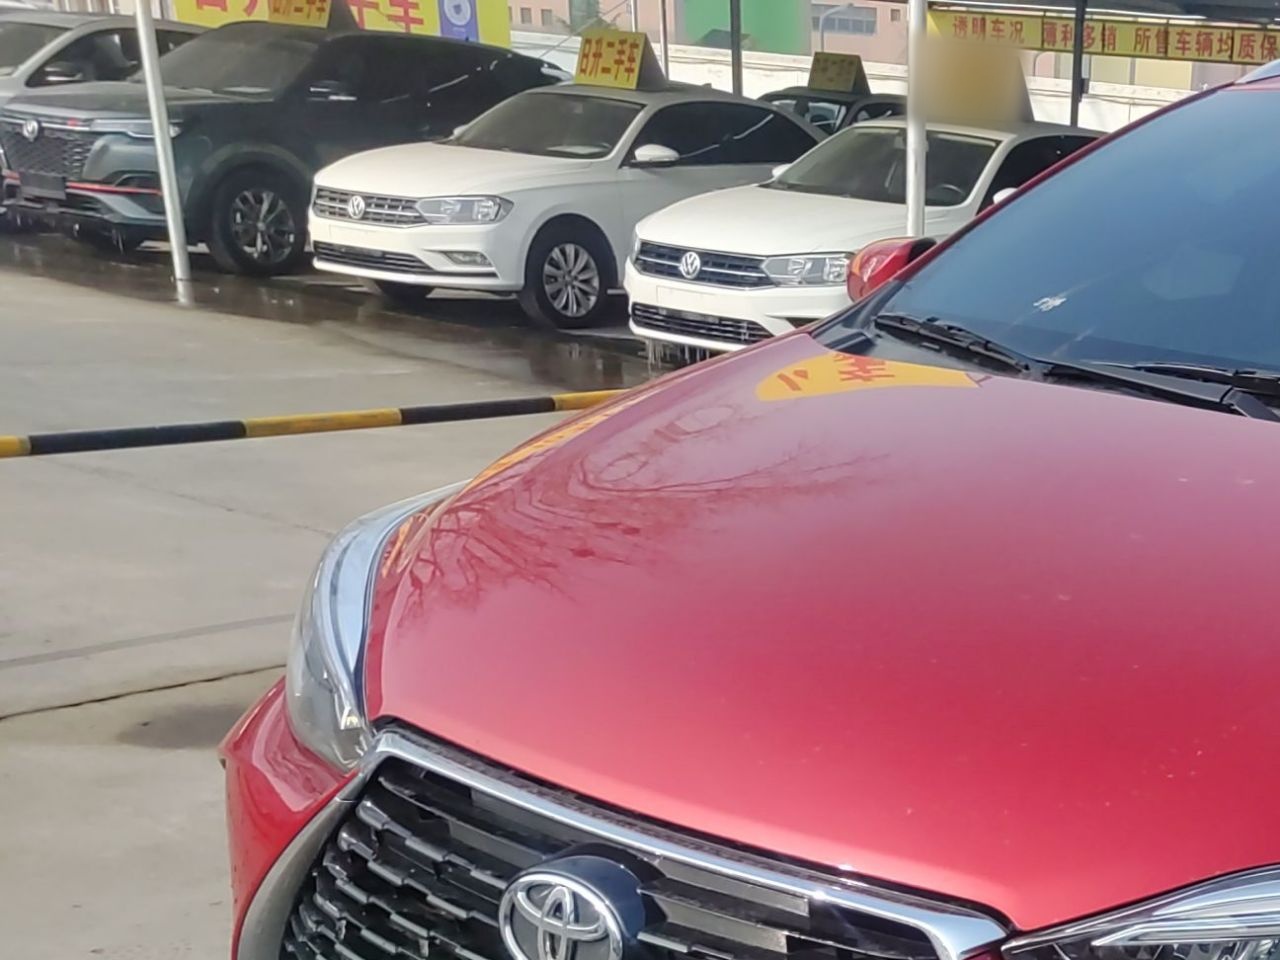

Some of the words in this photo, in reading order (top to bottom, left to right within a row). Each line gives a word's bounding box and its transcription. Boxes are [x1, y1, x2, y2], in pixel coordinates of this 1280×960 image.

[952, 15, 1025, 44] 透明车况
[579, 37, 640, 82] 日升二手车
